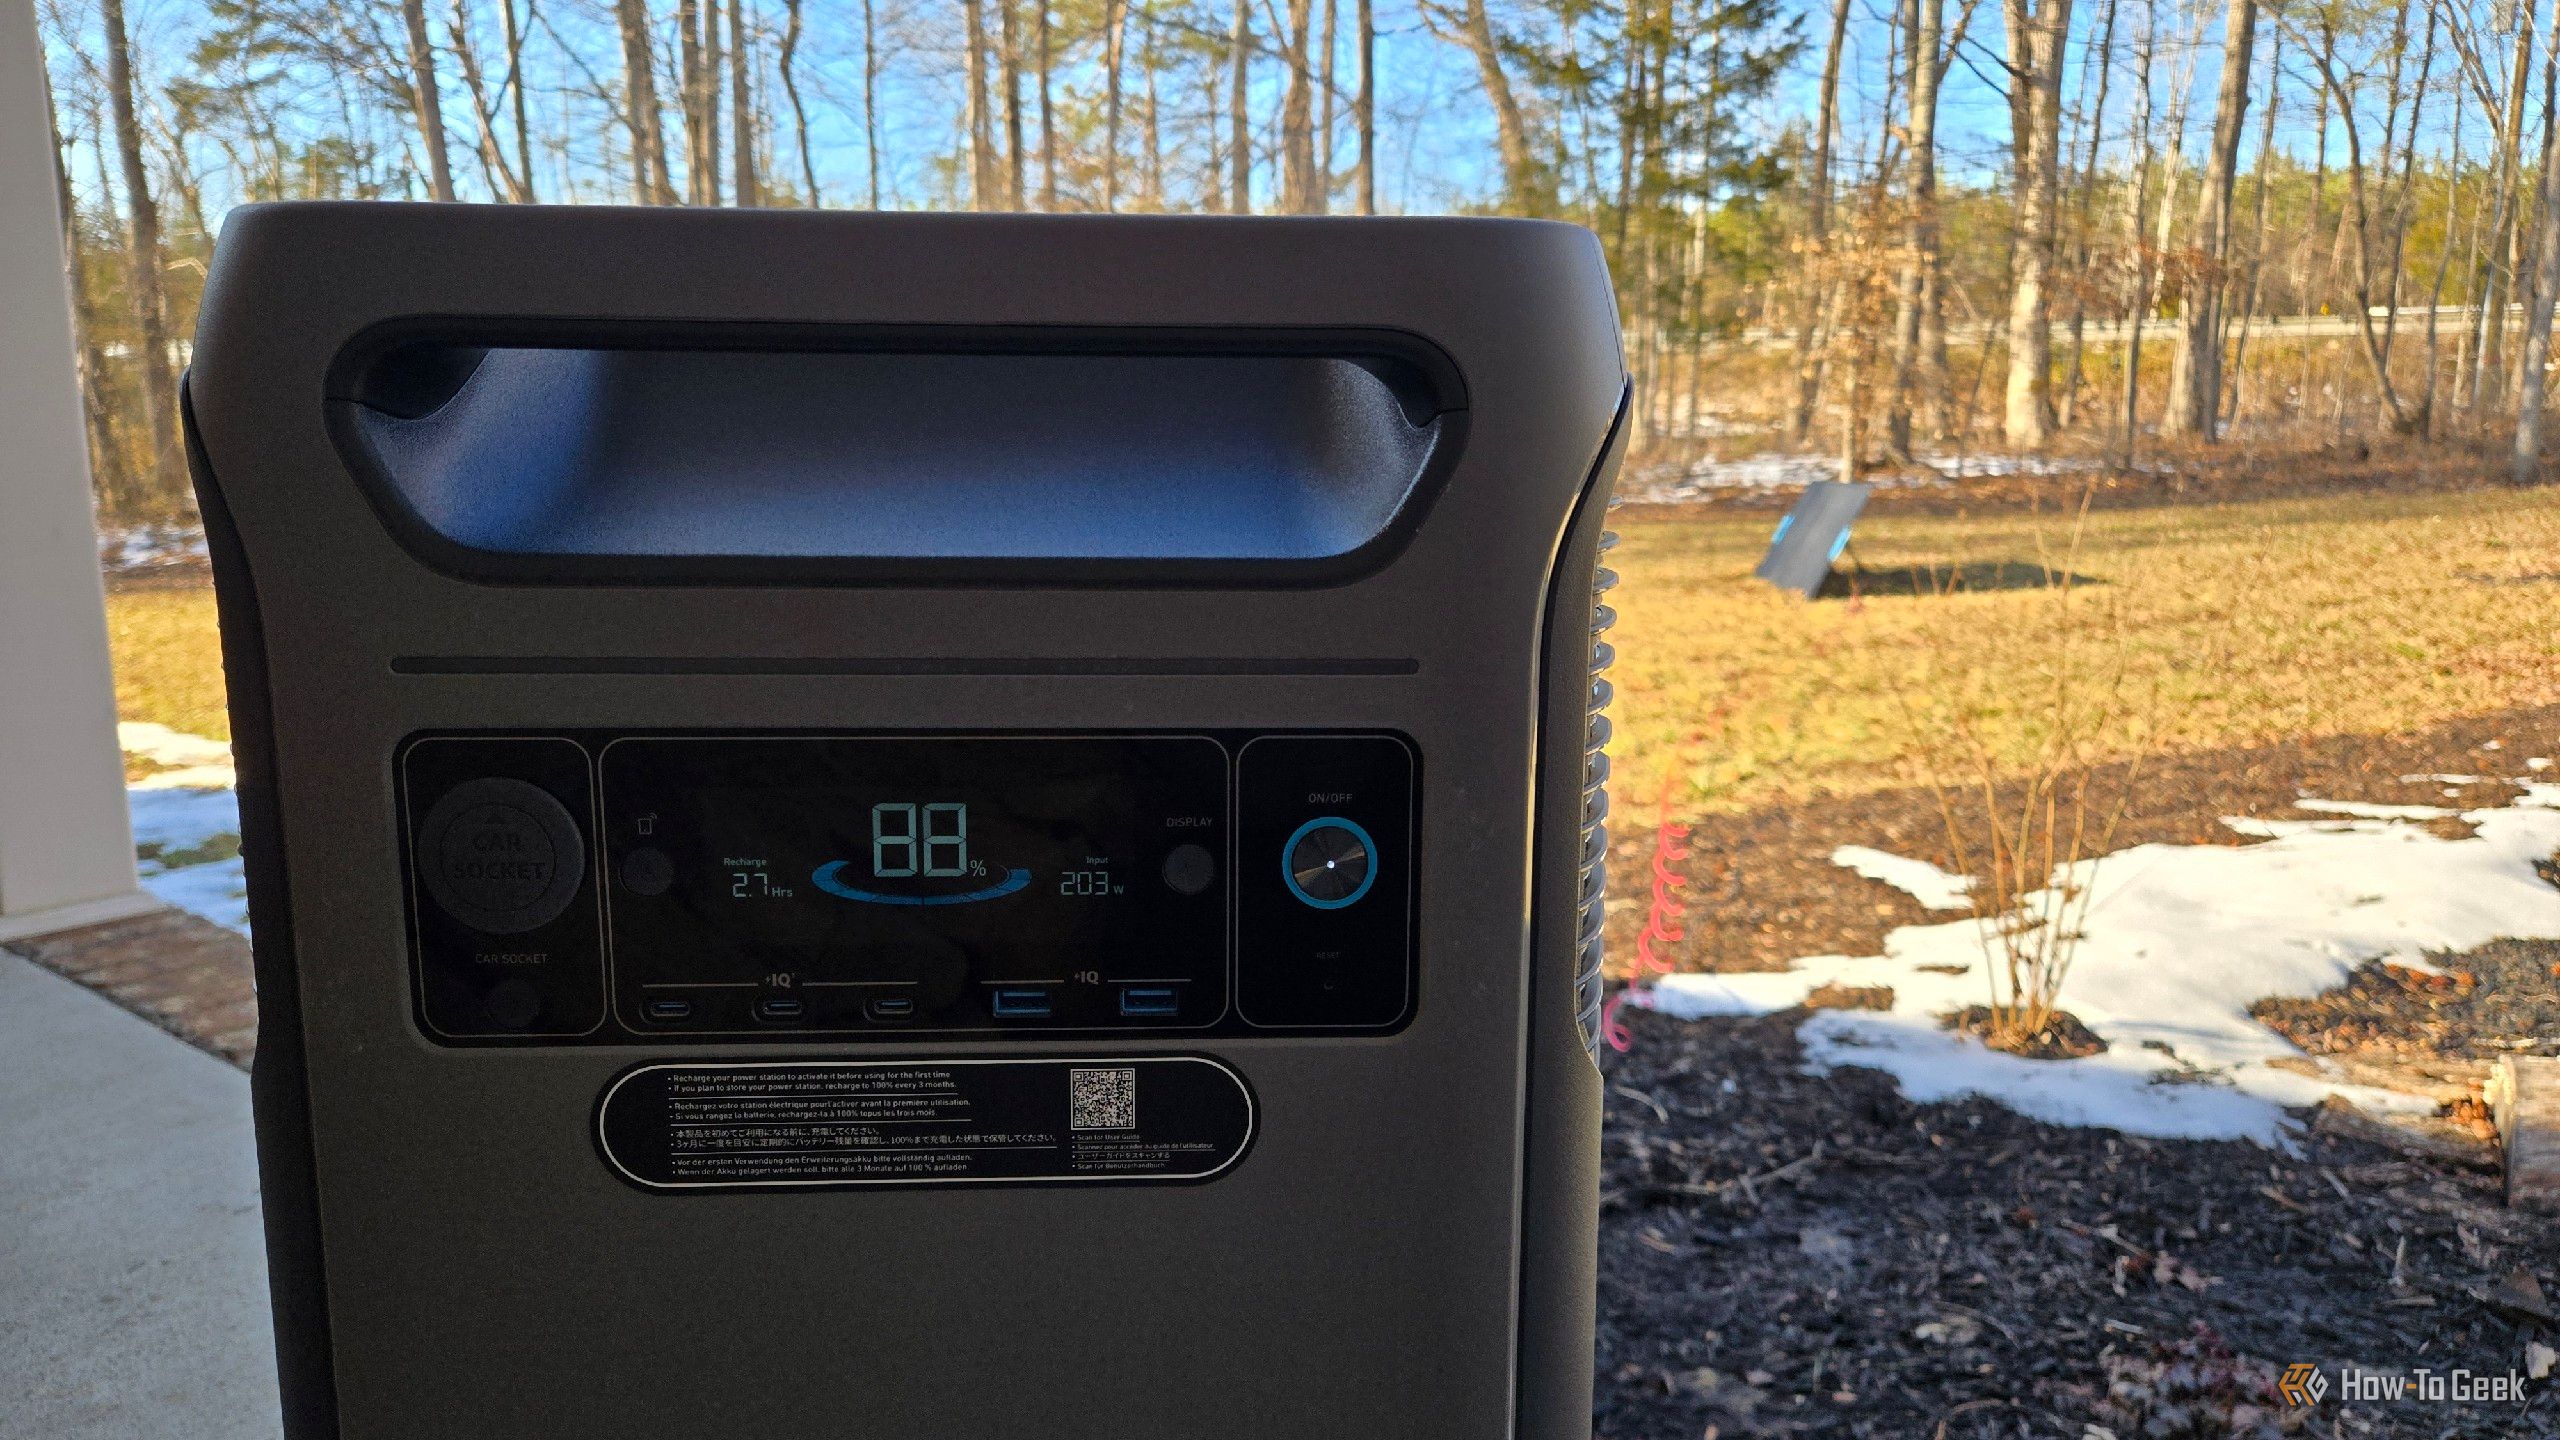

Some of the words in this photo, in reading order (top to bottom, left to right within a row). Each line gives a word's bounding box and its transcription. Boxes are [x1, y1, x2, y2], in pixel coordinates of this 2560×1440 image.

[1308, 792, 1353, 804] ON/OFF
[1166, 816, 1213, 829] DISPLAY
[474, 832, 521, 852] CAR
[723, 856, 768, 869] Recharge
[1086, 855, 1109, 868] Input
[454, 862, 545, 880] SOCKET
[1059, 870, 1109, 896] 203
[475, 953, 499, 965] CAR
[502, 952, 548, 965] SOCKET
[674, 1075, 710, 1084] Recharge
[760, 1073, 786, 1081] station
[838, 1072, 862, 1080] before
[864, 1072, 885, 1081] using
[900, 1071, 913, 1079] the
[914, 1071, 930, 1079] first
[698, 1084, 714, 1093] plan
[727, 1083, 746, 1091] store
[826, 1082, 860, 1091] recharge
[872, 1081, 894, 1089] 100%
[769, 1100, 808, 1109] électrique
[860, 1099, 882, 1107] avant
[892, 1099, 928, 1108] première
[706, 1113, 732, 1121] rangez
[734, 1157, 783, 1166] Verwendung
[785, 1156, 800, 1164] den
[702, 1167, 714, 1175] der
[738, 1167, 770, 1176] gelagert
[772, 1166, 802, 1174] werden
[822, 1165, 838, 1173] bitte
[842, 1165, 855, 1173] alle
